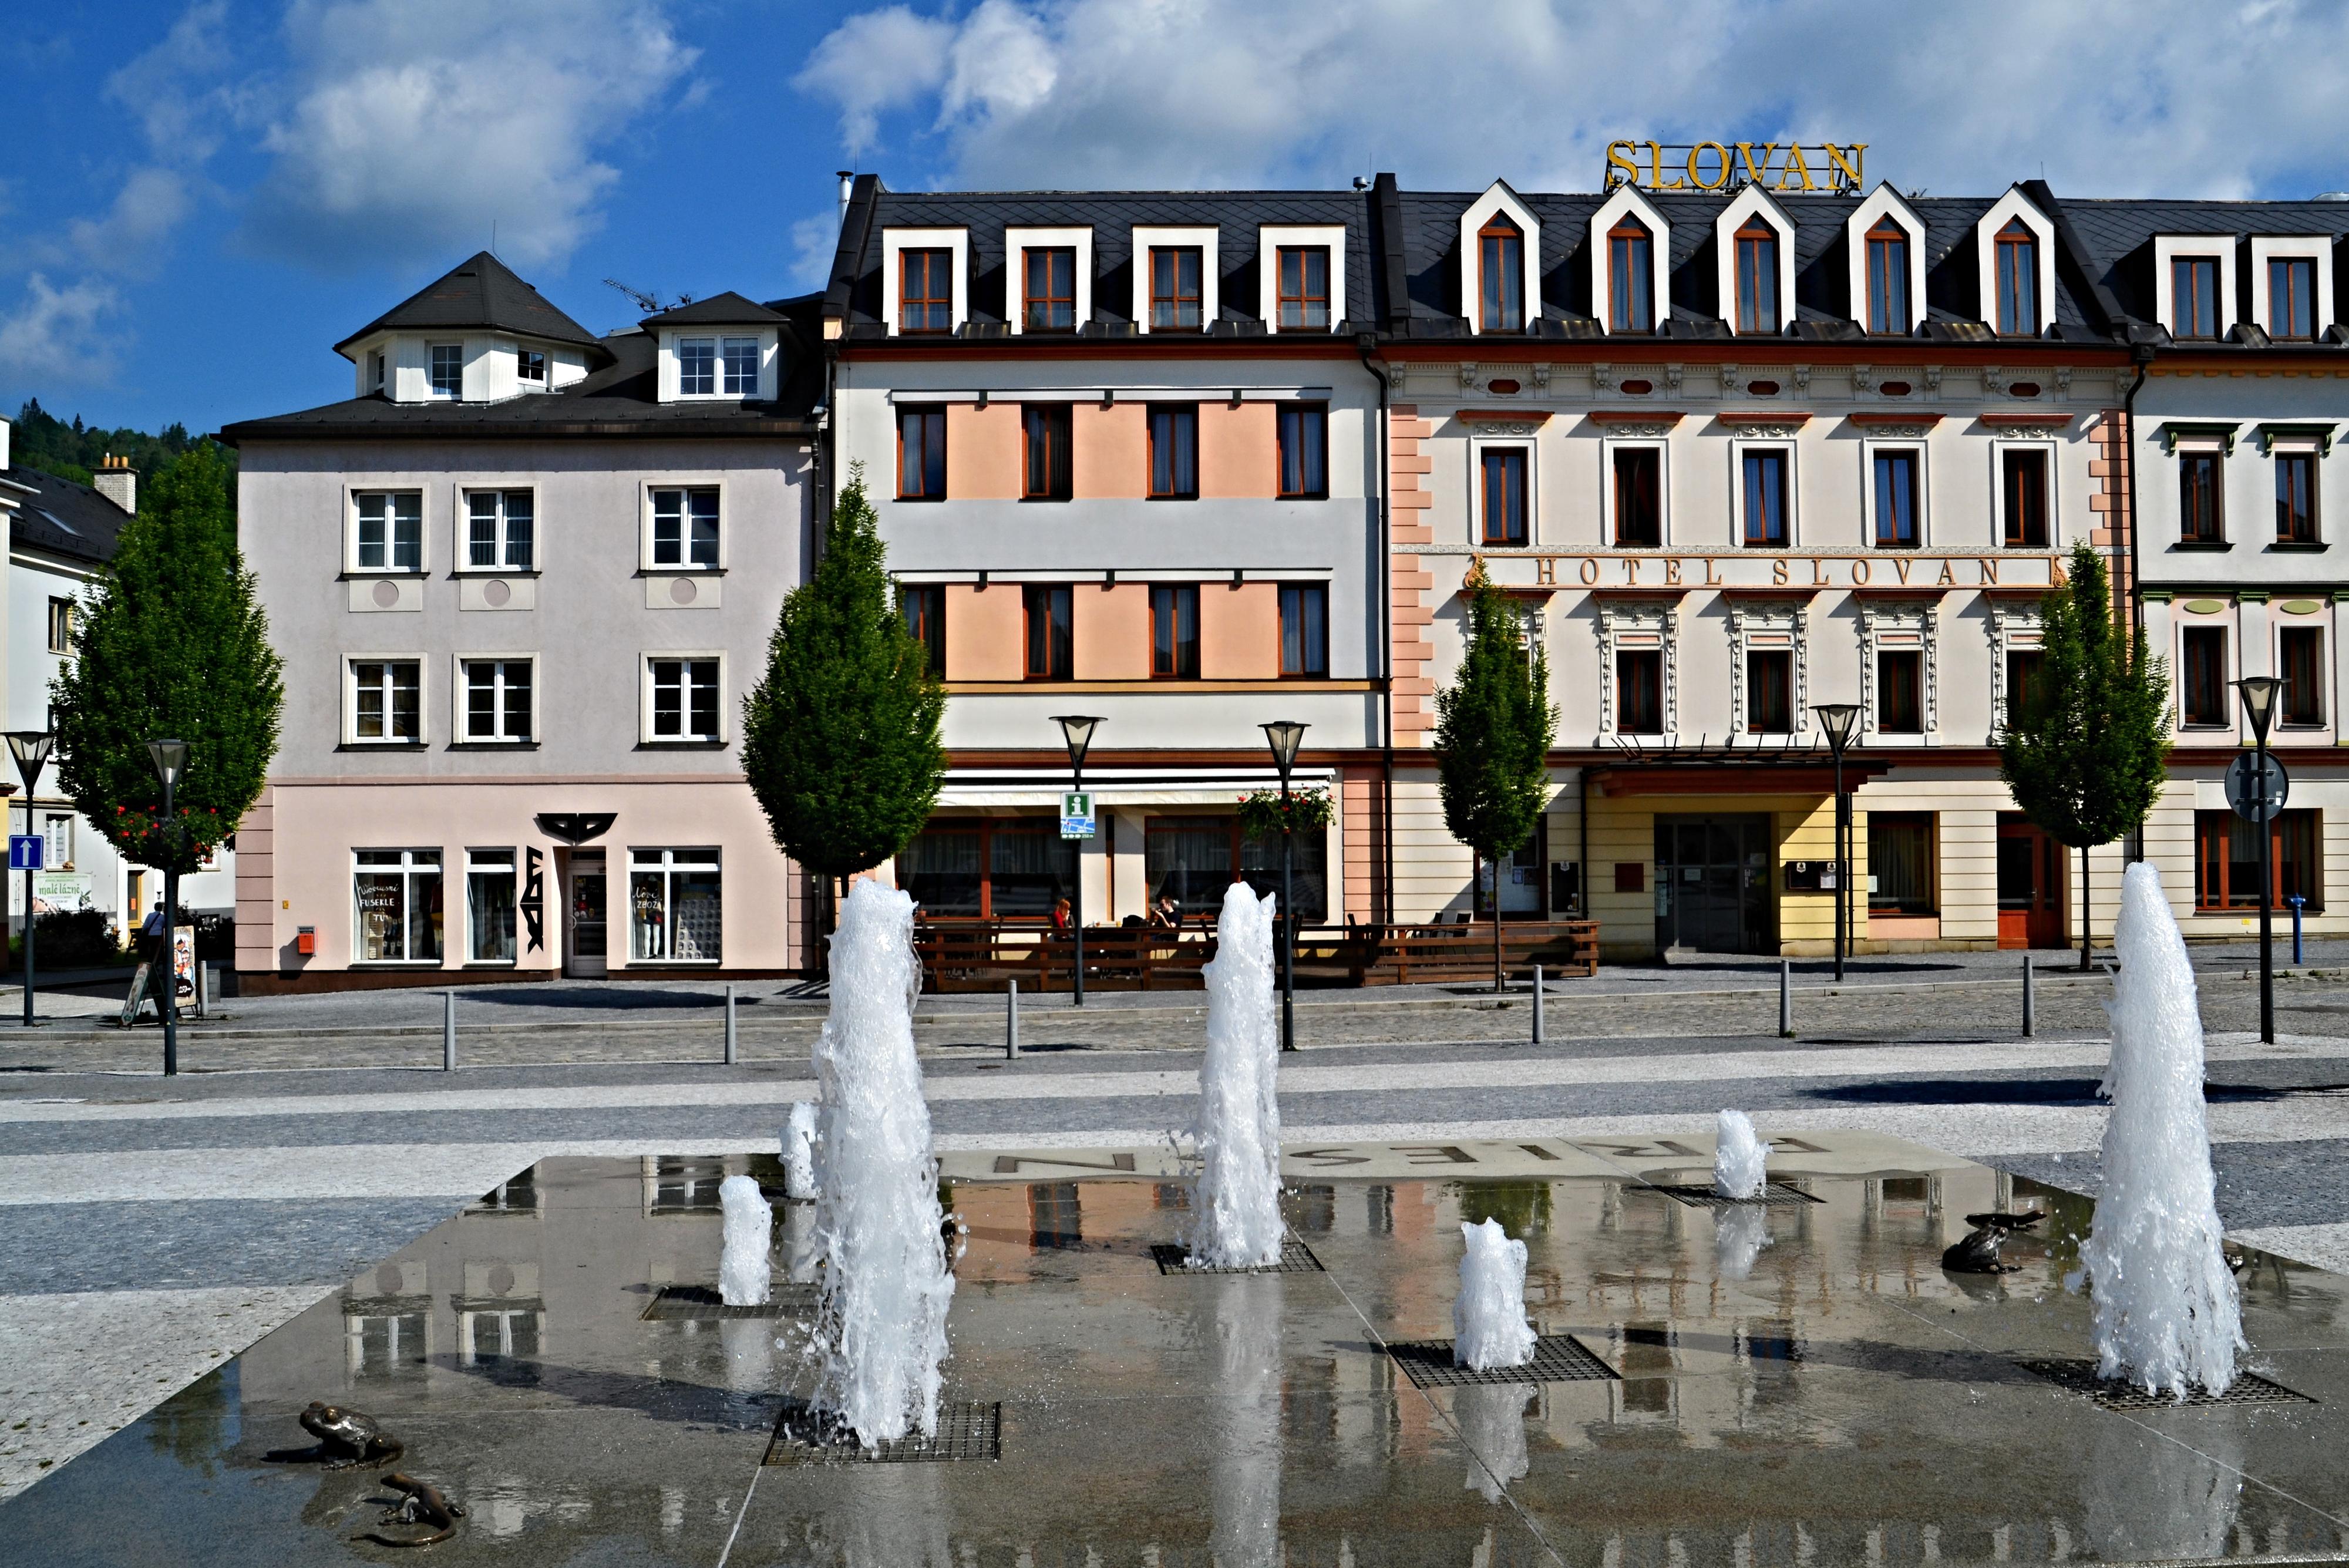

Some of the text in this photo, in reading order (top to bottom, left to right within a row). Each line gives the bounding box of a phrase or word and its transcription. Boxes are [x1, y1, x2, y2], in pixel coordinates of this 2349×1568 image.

[1606, 140, 1869, 191] SLOVAN
[1536, 558, 2001, 586] HOTEL SLOVAN
[39, 883, 80, 895] malé lázně
[360, 898, 395, 907] FUSEKLE
